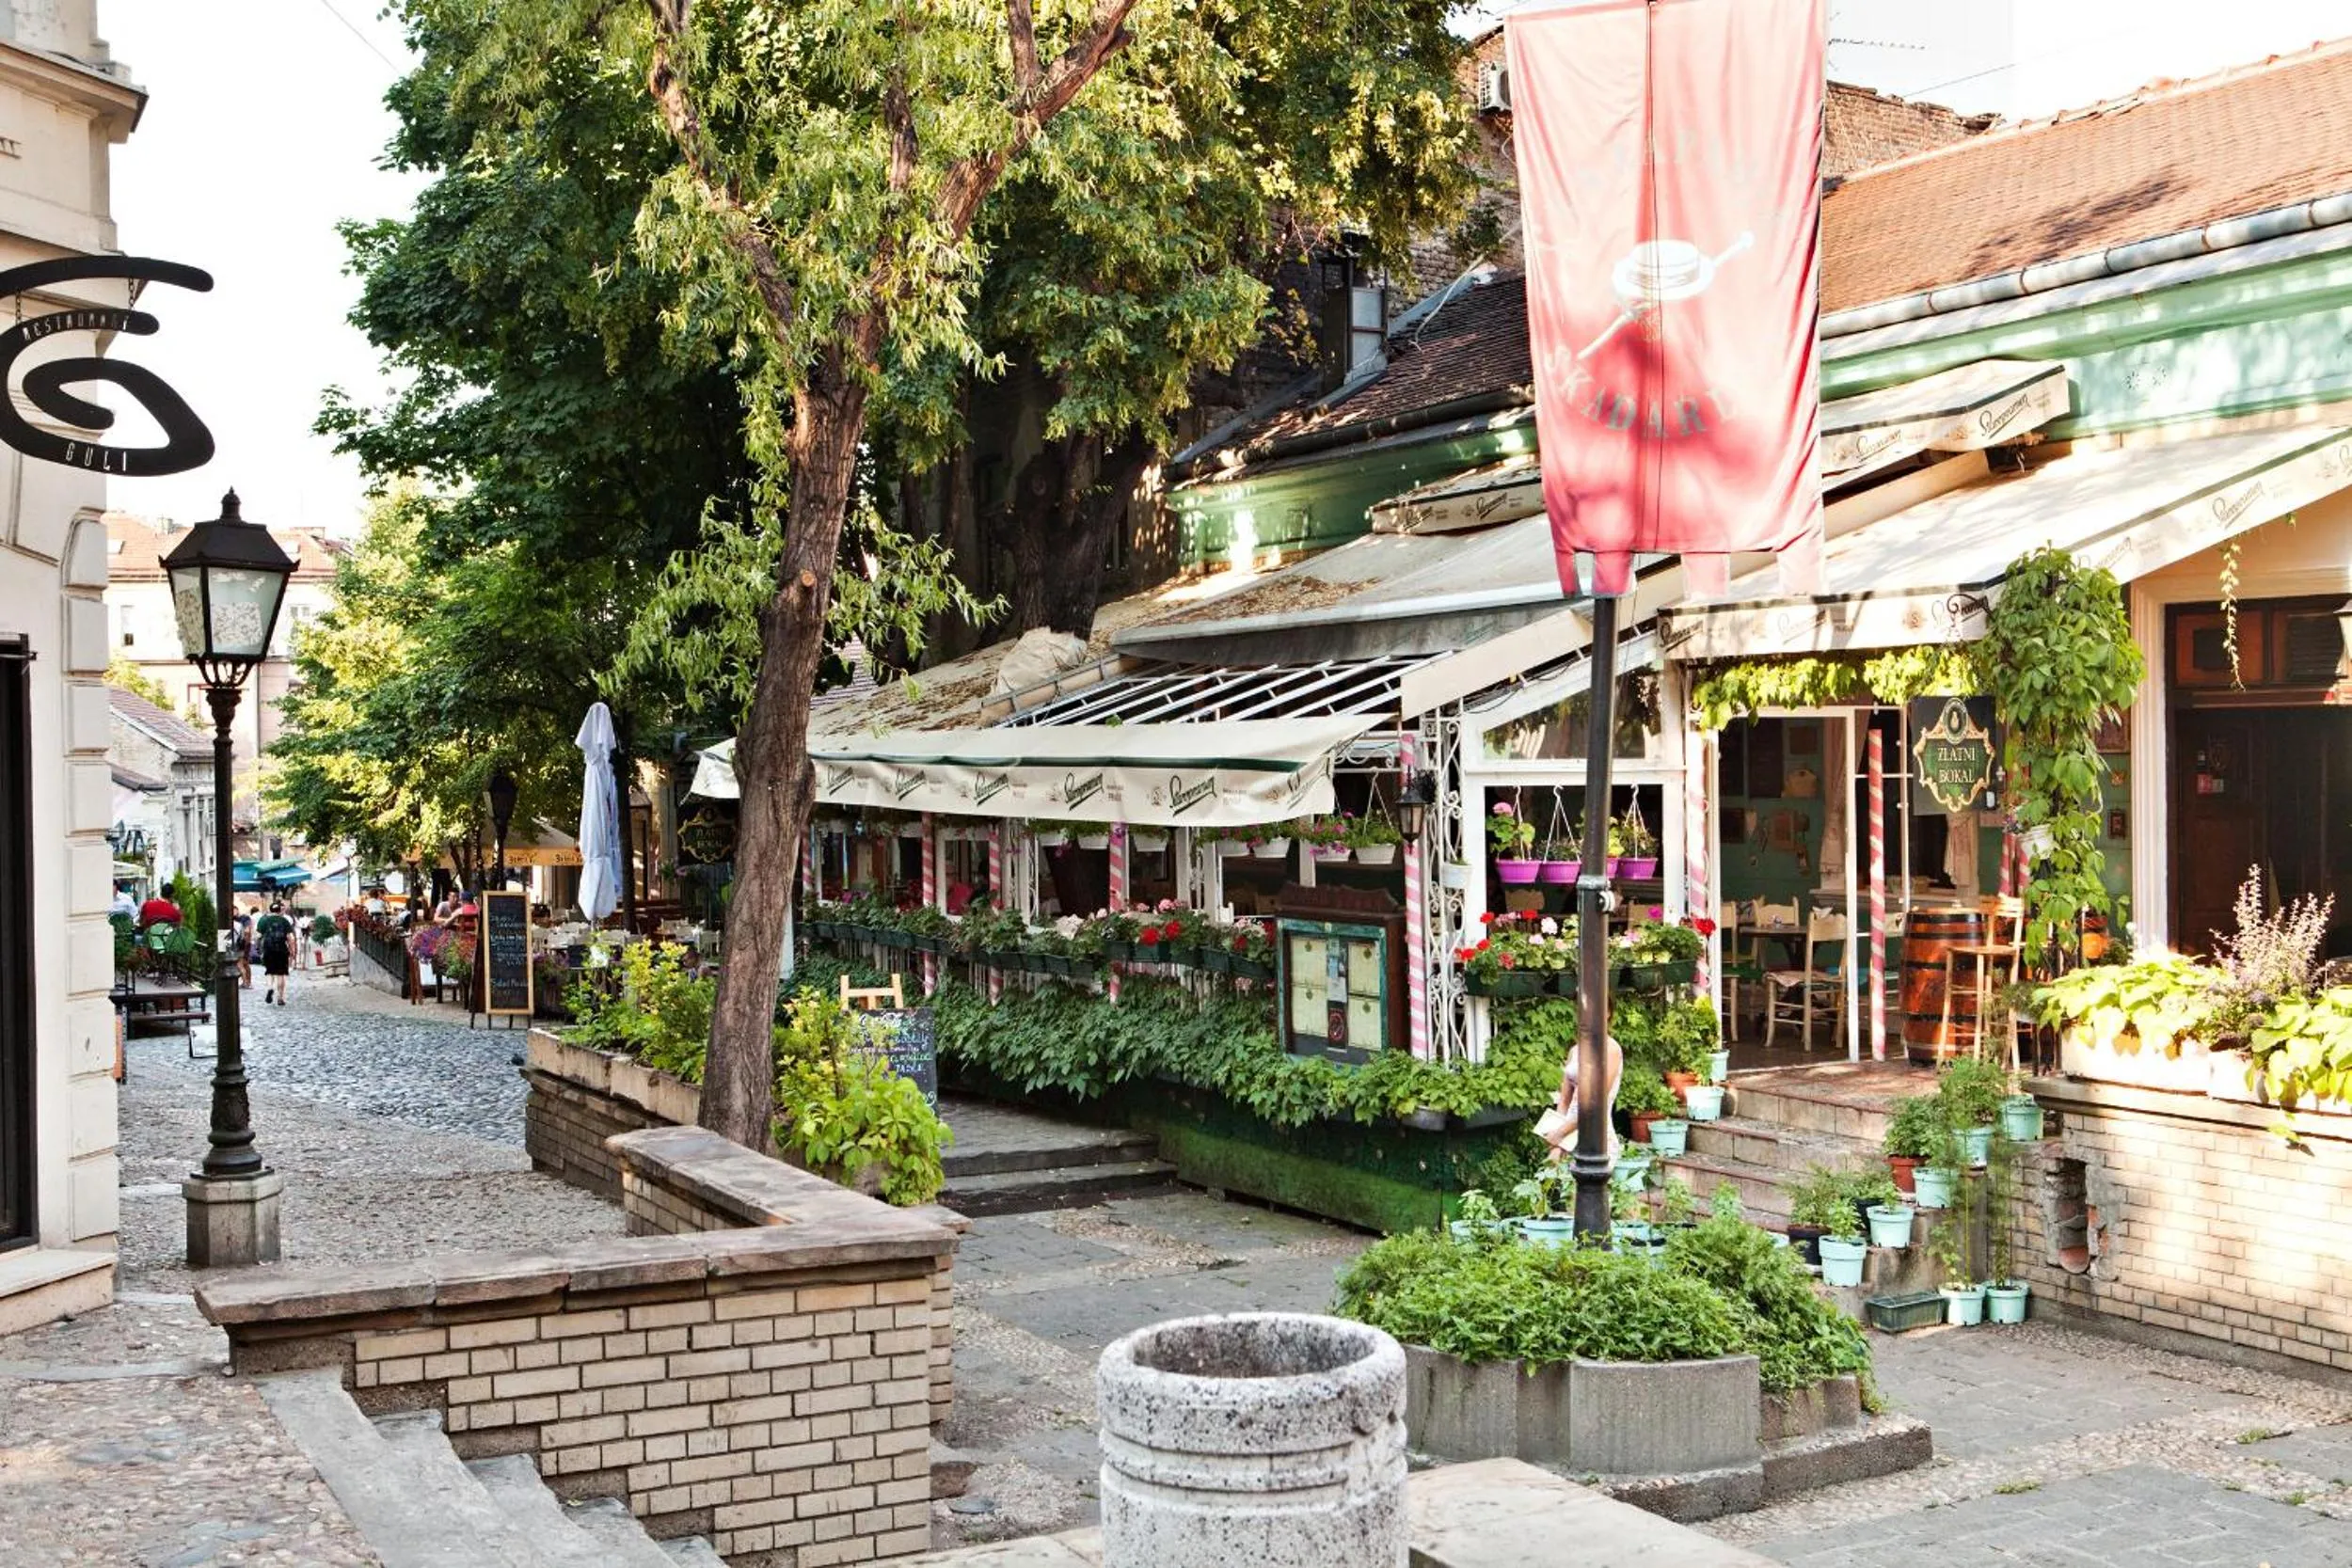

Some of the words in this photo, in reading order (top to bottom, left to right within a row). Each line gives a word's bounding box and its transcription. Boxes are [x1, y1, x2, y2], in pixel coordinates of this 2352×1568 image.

[65, 441, 127, 472] GULI
[1937, 747, 1976, 762] ZLATNI
[1938, 769, 1976, 784] BOKAL
